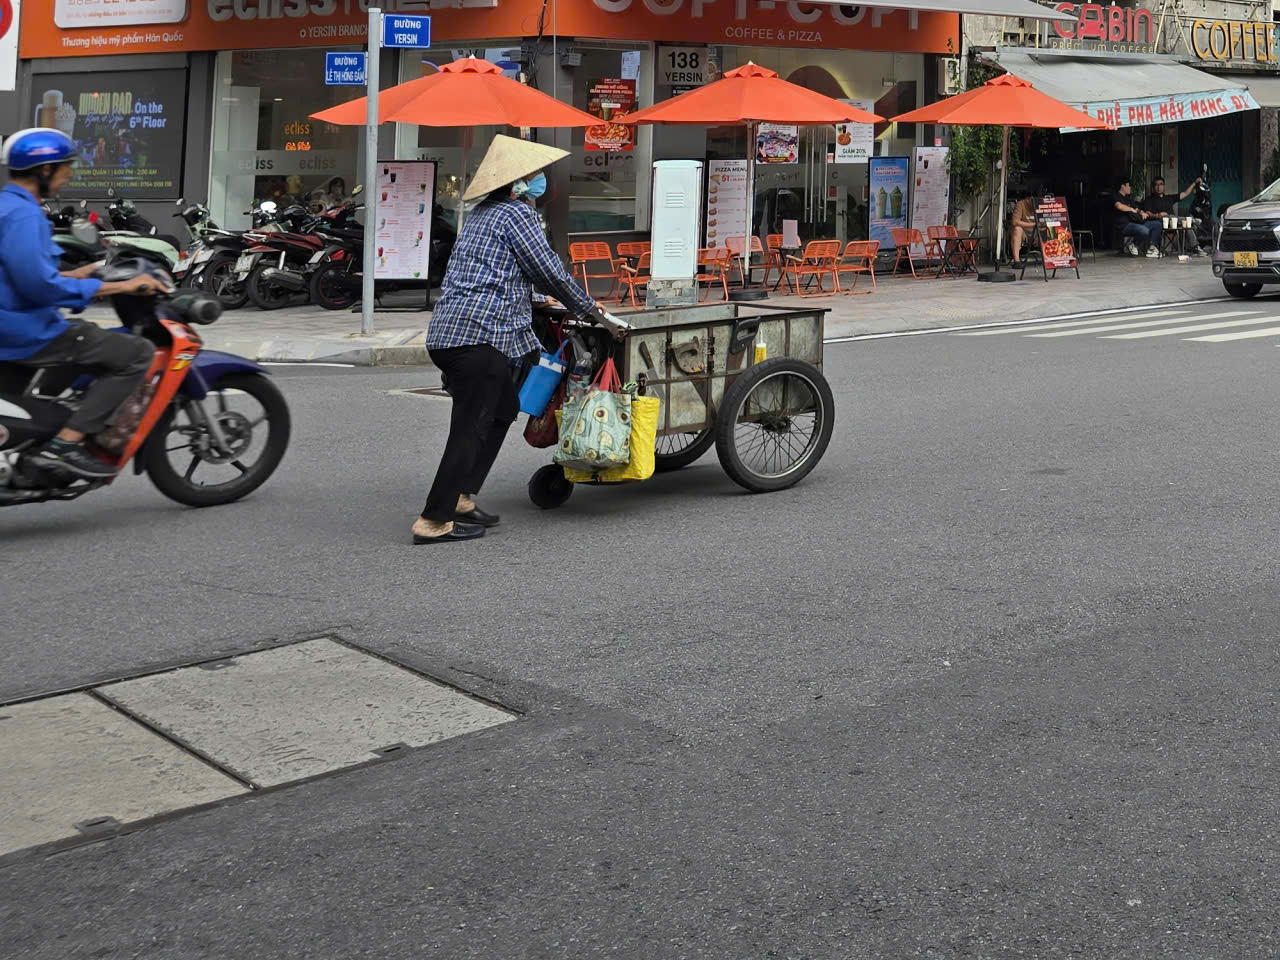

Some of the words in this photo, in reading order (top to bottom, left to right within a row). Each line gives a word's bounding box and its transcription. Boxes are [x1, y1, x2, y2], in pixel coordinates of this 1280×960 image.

[394, 19, 421, 29] ĐƯỜNG
[308, 25, 337, 38] YERSIN
[725, 26, 774, 40] COFFEE
[777, 29, 785, 40] &
[788, 30, 823, 42] PIZZA
[62, 36, 90, 48] Thương
[91, 35, 107, 46] hiệu
[162, 30, 184, 43] Quốc
[394, 33, 418, 44] YERSIN
[1191, 20, 1279, 61] COFFEE
[334, 55, 358, 66] ĐƯỜNG
[668, 51, 700, 69] 138
[326, 69, 332, 81] LÊ
[665, 71, 703, 83] YERSIN
[134, 102, 147, 114] On
[148, 101, 163, 113] the
[1128, 105, 1154, 124] PHA
[1190, 97, 1228, 118] MANG
[129, 116, 142, 128] 6th
[142, 116, 167, 128] Floor
[284, 120, 311, 135] ecliss
